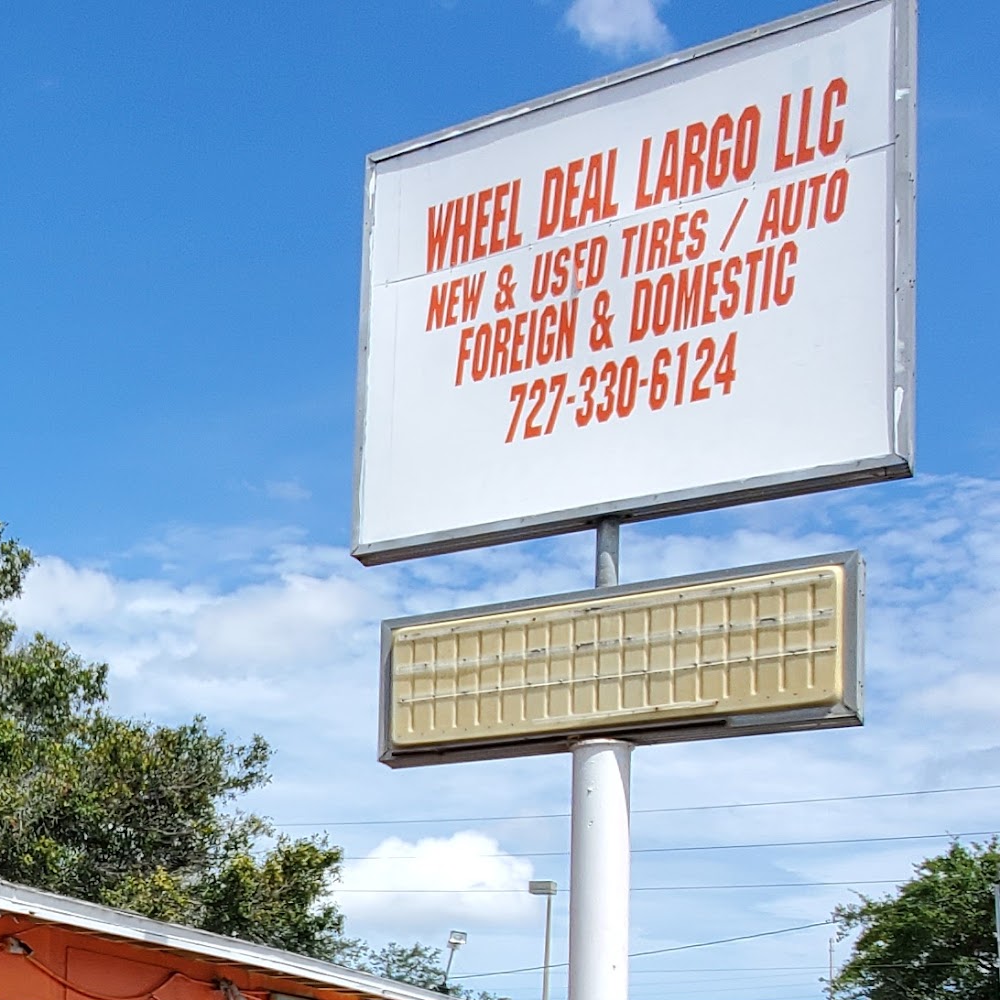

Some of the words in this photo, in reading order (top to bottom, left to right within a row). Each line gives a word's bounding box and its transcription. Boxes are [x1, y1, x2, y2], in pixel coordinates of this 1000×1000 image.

[426, 272, 486, 331] NEW
[493, 264, 516, 313] &
[530, 235, 608, 302] USED
[621, 208, 709, 278] TIRES
[720, 199, 748, 251] /
[757, 168, 849, 243] AUTO
[427, 179, 522, 273] WHEEL
[538, 148, 618, 239] DEAL
[635, 105, 761, 210] LARGO
[774, 77, 848, 171] LLC
[455, 297, 579, 386] FOREIGN
[589, 289, 613, 352] &
[628, 241, 798, 342] DOMESTIC
[505, 332, 737, 443] 727-330-6124
